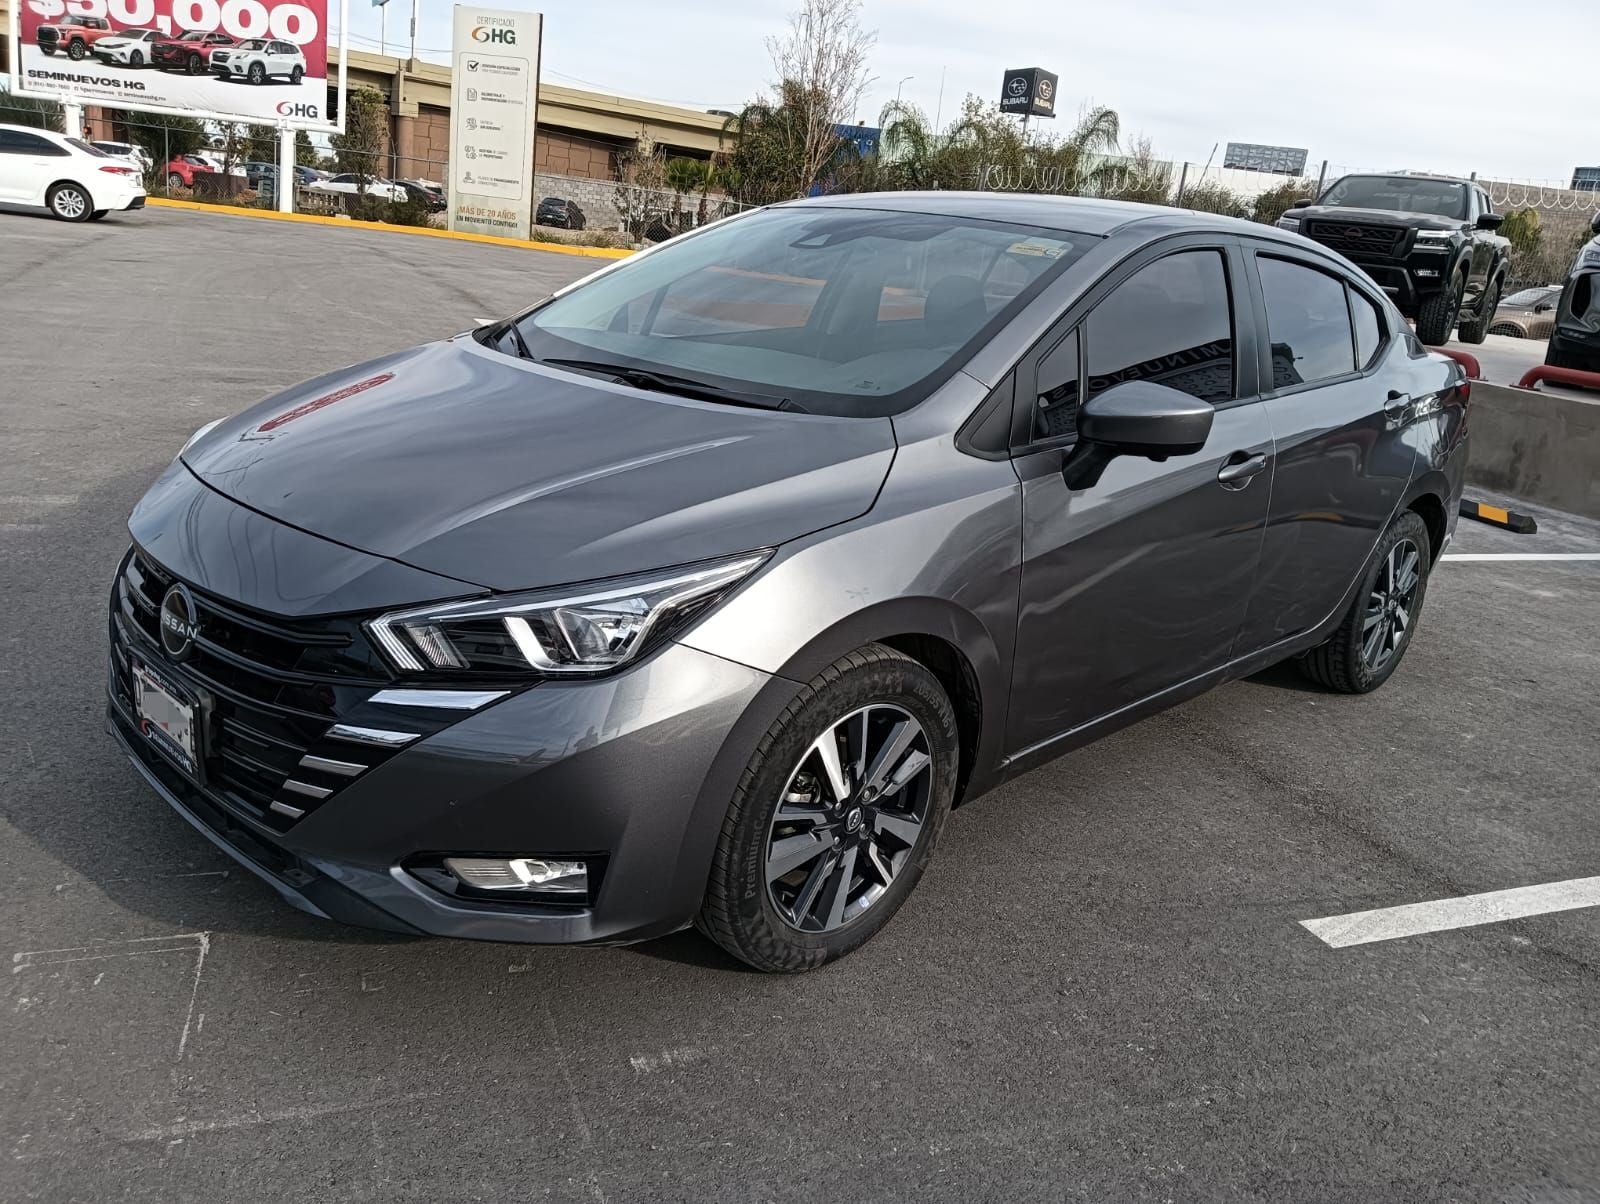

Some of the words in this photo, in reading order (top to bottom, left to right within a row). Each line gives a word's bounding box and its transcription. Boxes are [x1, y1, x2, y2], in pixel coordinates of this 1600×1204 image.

[476, 15, 515, 27] CERTIFICADO
[491, 28, 516, 45] HG
[27, 69, 121, 88] SEMINUEVOS
[124, 80, 145, 90] HG
[295, 103, 317, 118] HG
[476, 207, 487, 217] DE
[487, 209, 496, 218] 20
[497, 209, 516, 220] AÑOS
[162, 613, 198, 639] SSAN
